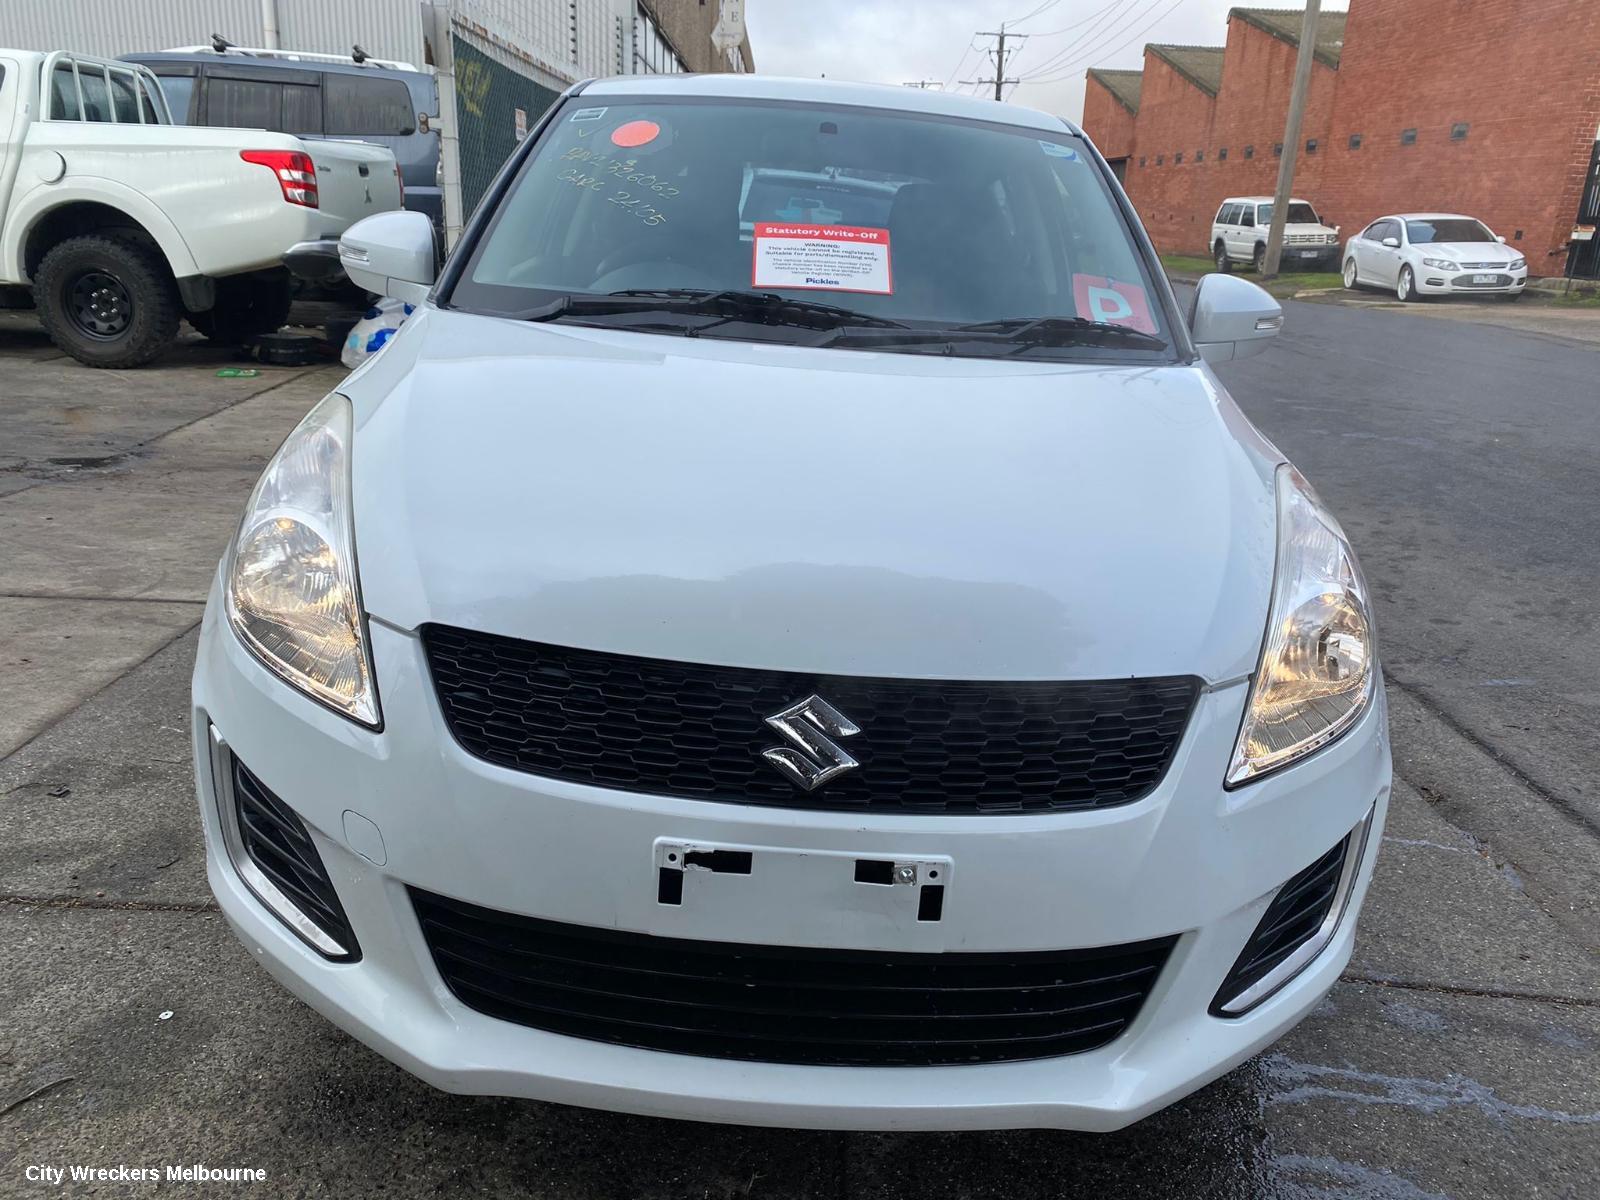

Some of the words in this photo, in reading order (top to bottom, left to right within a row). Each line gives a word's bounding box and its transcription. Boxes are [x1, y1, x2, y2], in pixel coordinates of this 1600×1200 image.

[765, 227, 820, 236] Statutory
[823, 227, 878, 239] Write-Off
[805, 277, 840, 285] Pickles
[1088, 285, 1133, 325] P
